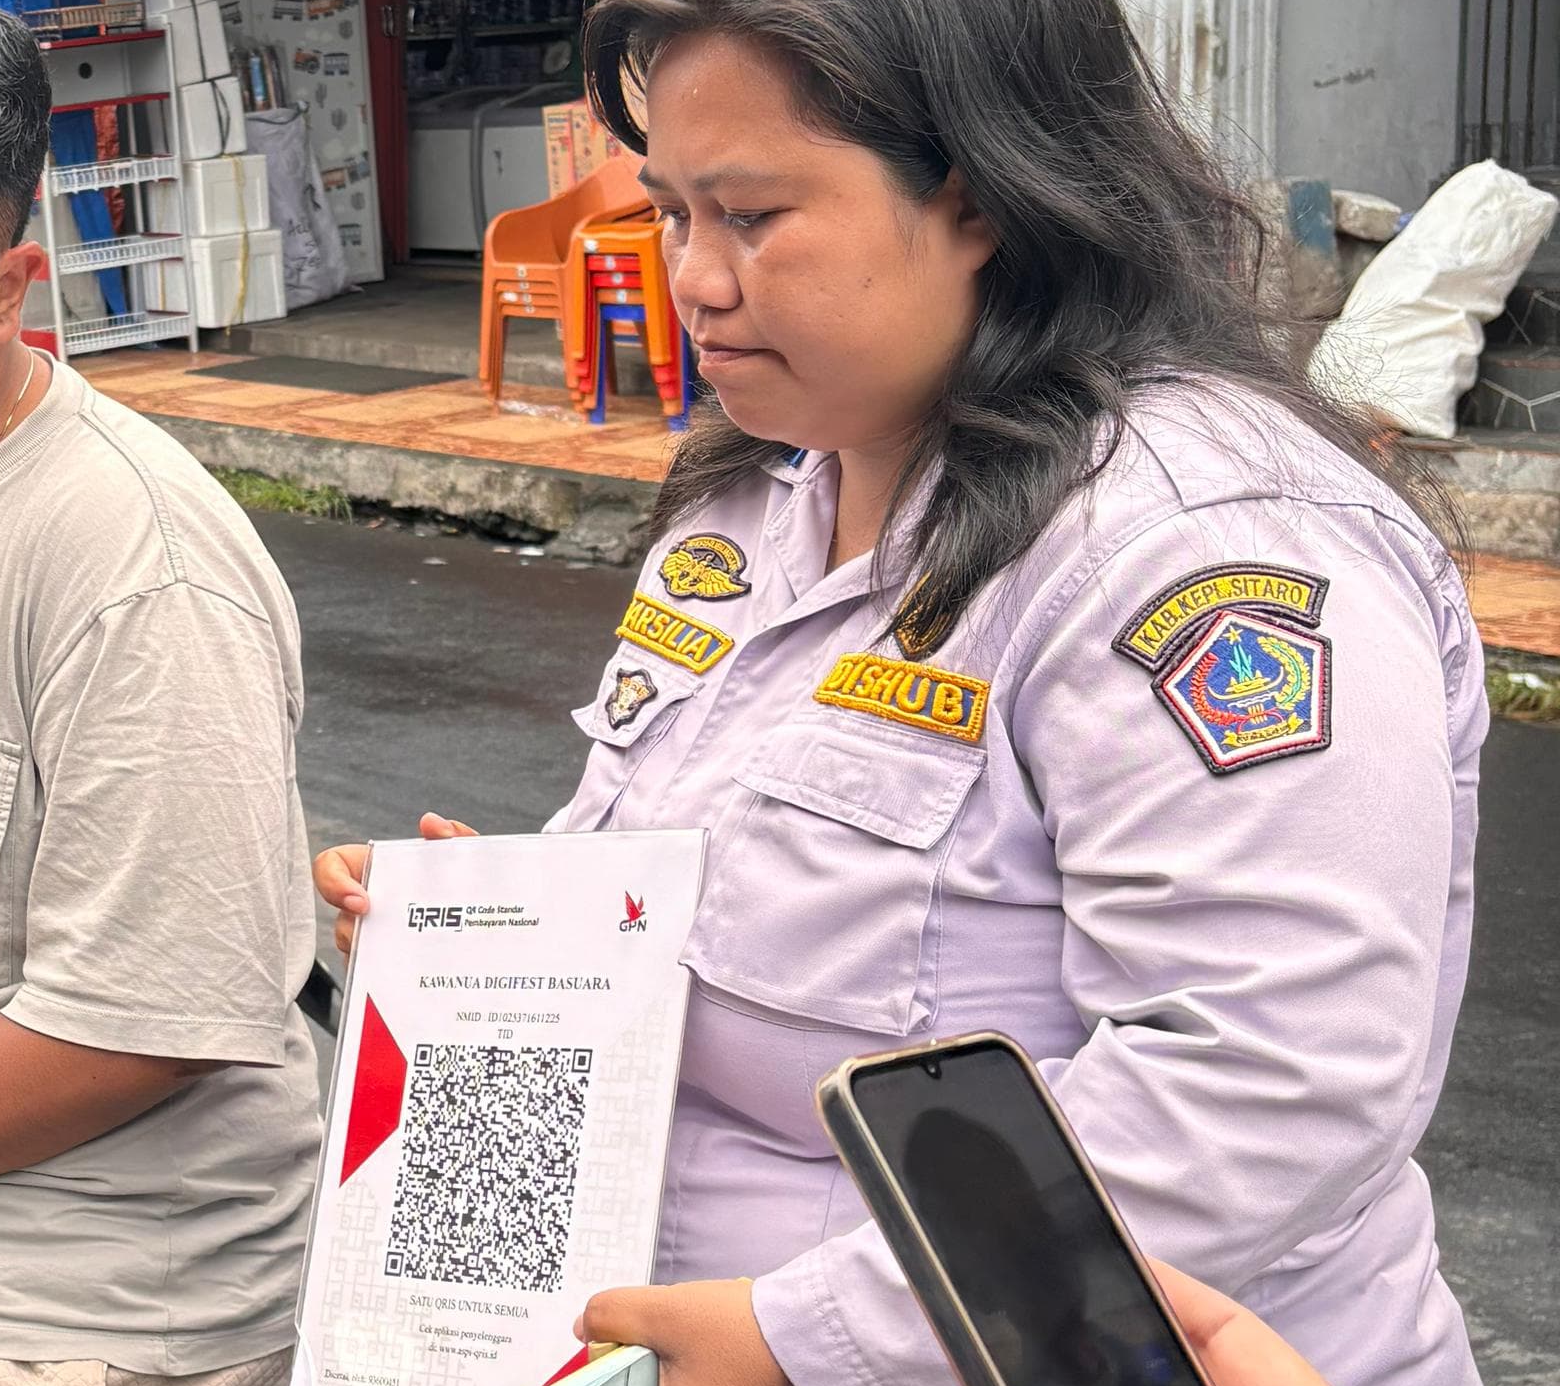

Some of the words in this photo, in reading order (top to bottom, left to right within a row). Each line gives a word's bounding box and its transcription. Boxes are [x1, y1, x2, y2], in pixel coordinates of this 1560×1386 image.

[824, 661, 963, 724] DISHUB
[408, 907, 463, 932] QRIS
[478, 906, 495, 914] Code
[508, 917, 539, 926] Nasional
[619, 919, 647, 932] GPN
[419, 976, 481, 989] KAWANUA
[484, 976, 545, 990] DIGIFEST
[547, 977, 611, 990] BASUARA
[497, 1028, 514, 1039] TID
[409, 1294, 434, 1308] SATU
[435, 1297, 456, 1310] QRIS
[458, 1300, 492, 1314] UNTUK
[494, 1303, 529, 1318] SEMUA
